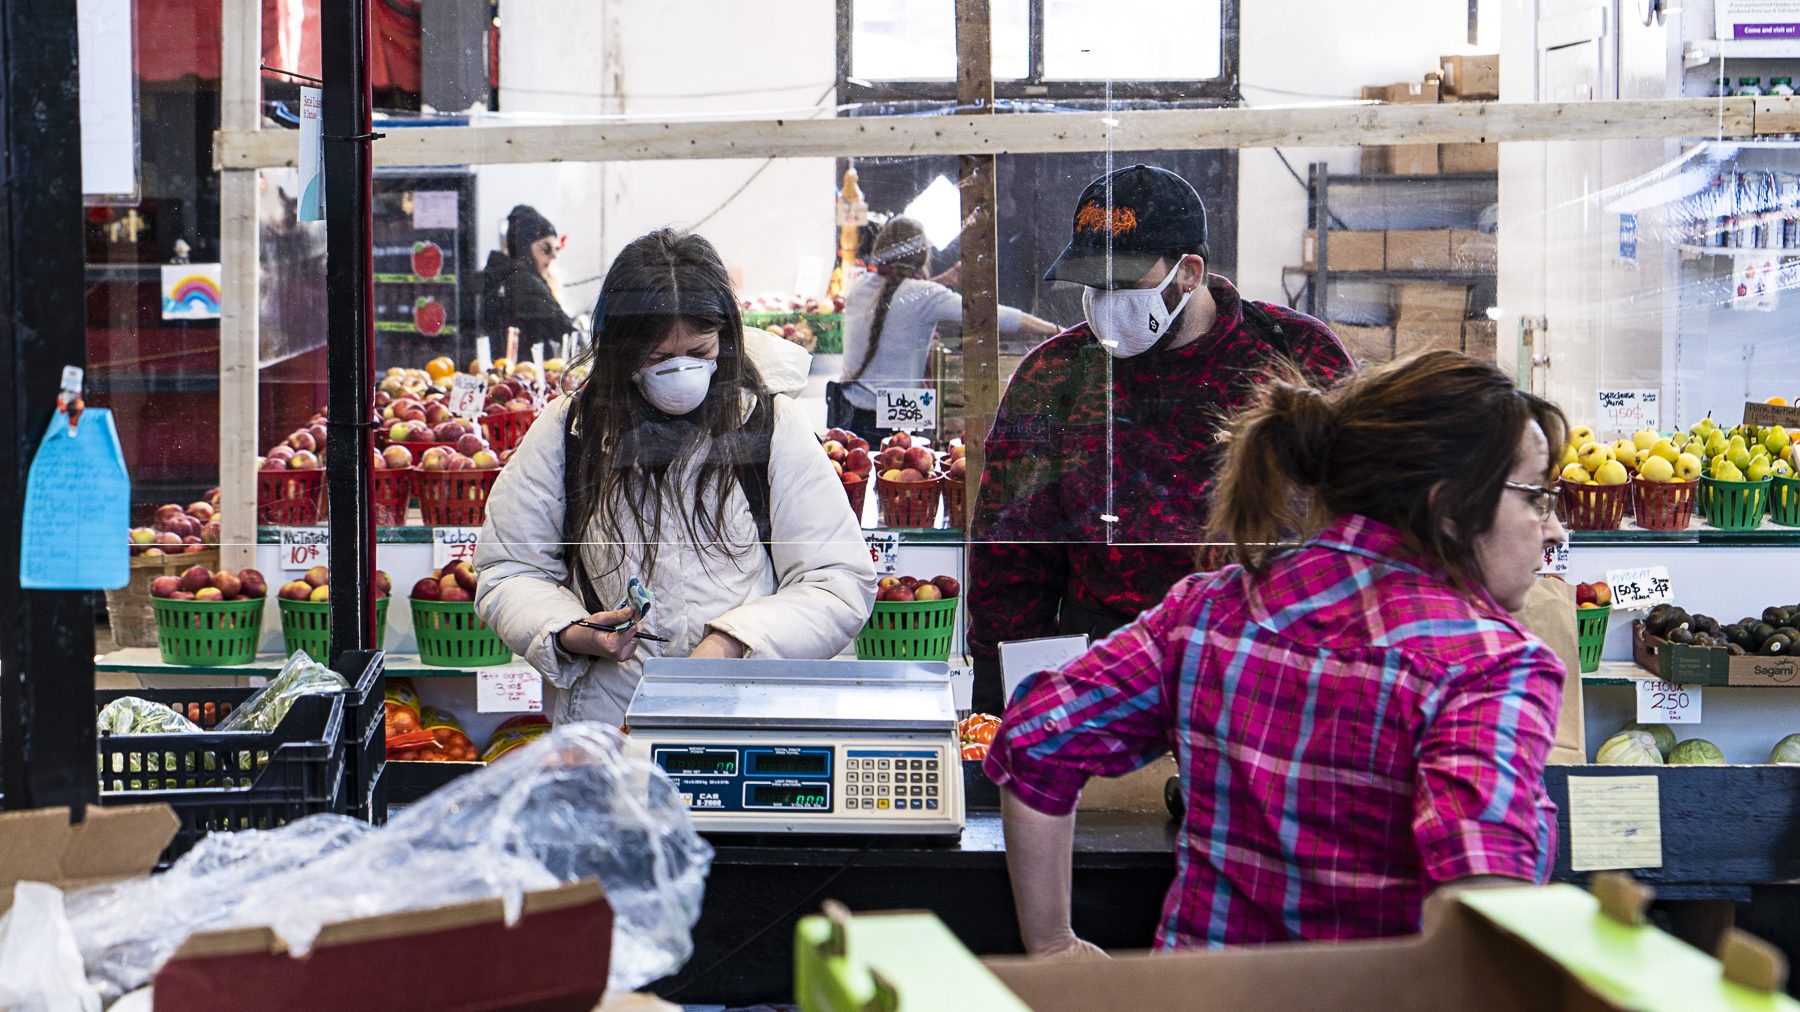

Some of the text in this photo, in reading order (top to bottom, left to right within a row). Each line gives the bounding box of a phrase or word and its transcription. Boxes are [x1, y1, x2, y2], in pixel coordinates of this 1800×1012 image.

[1773, 26, 1785, 34] visit
[1786, 26, 1796, 34] us!
[291, 544, 320, 564] 10$
[1754, 665, 1793, 677] Sagami
[1651, 692, 1690, 710] 2.50
